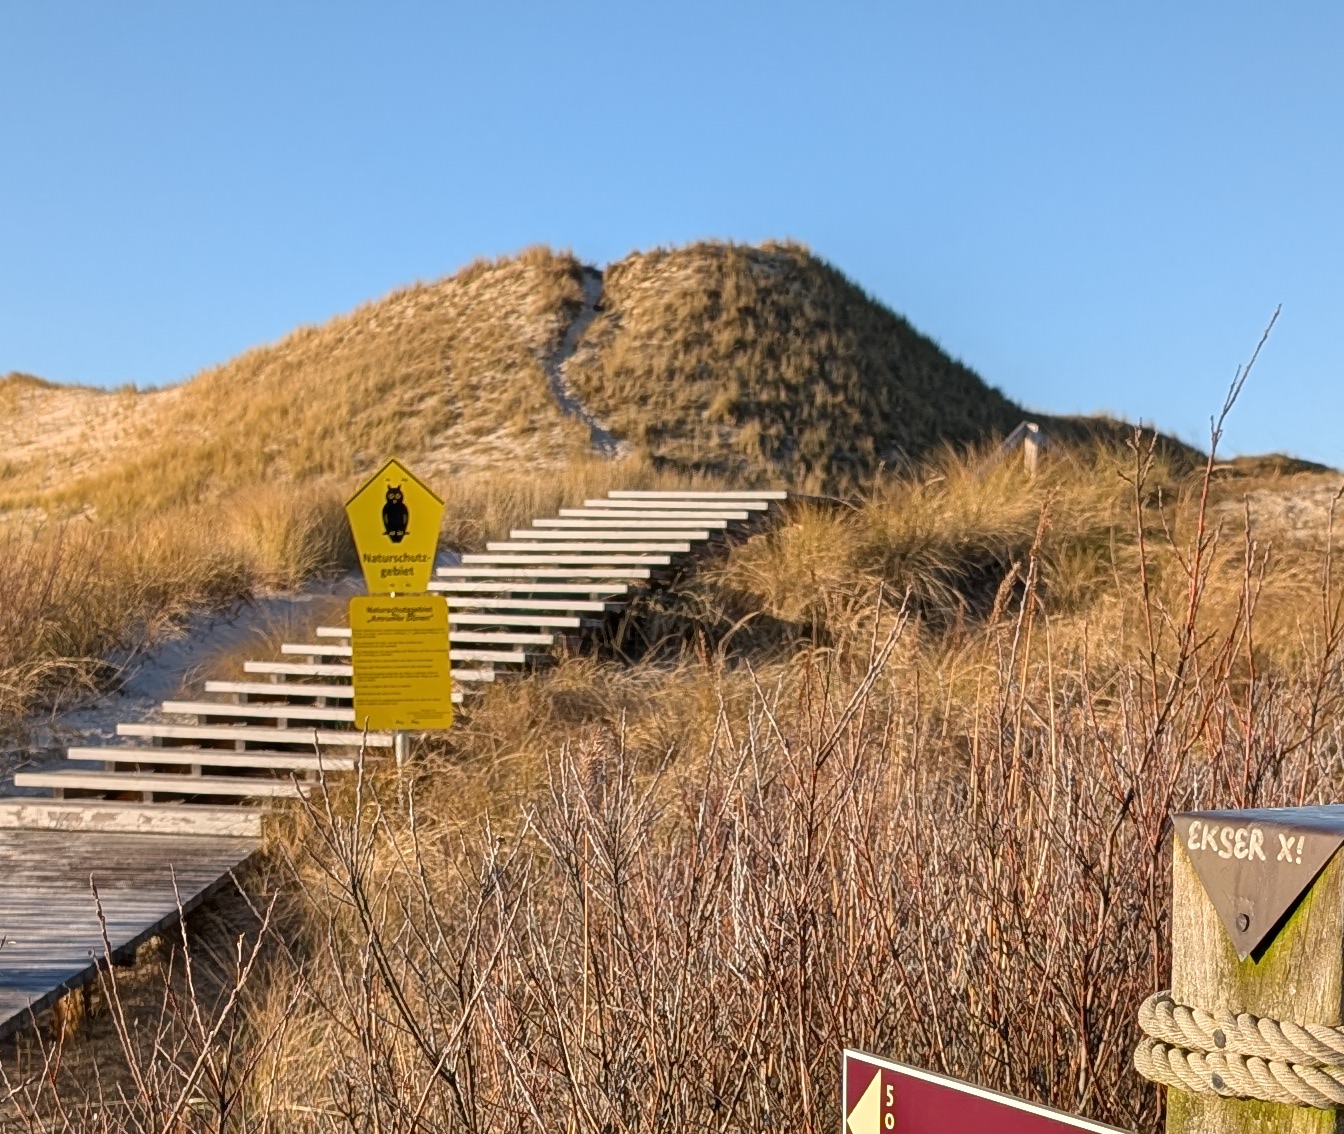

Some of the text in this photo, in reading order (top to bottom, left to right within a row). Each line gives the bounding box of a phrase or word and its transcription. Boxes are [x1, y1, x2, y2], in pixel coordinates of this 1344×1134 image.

[363, 552, 432, 564] Naturschutz-
[381, 565, 414, 578] gebiet
[1188, 820, 1266, 861] EKSER
